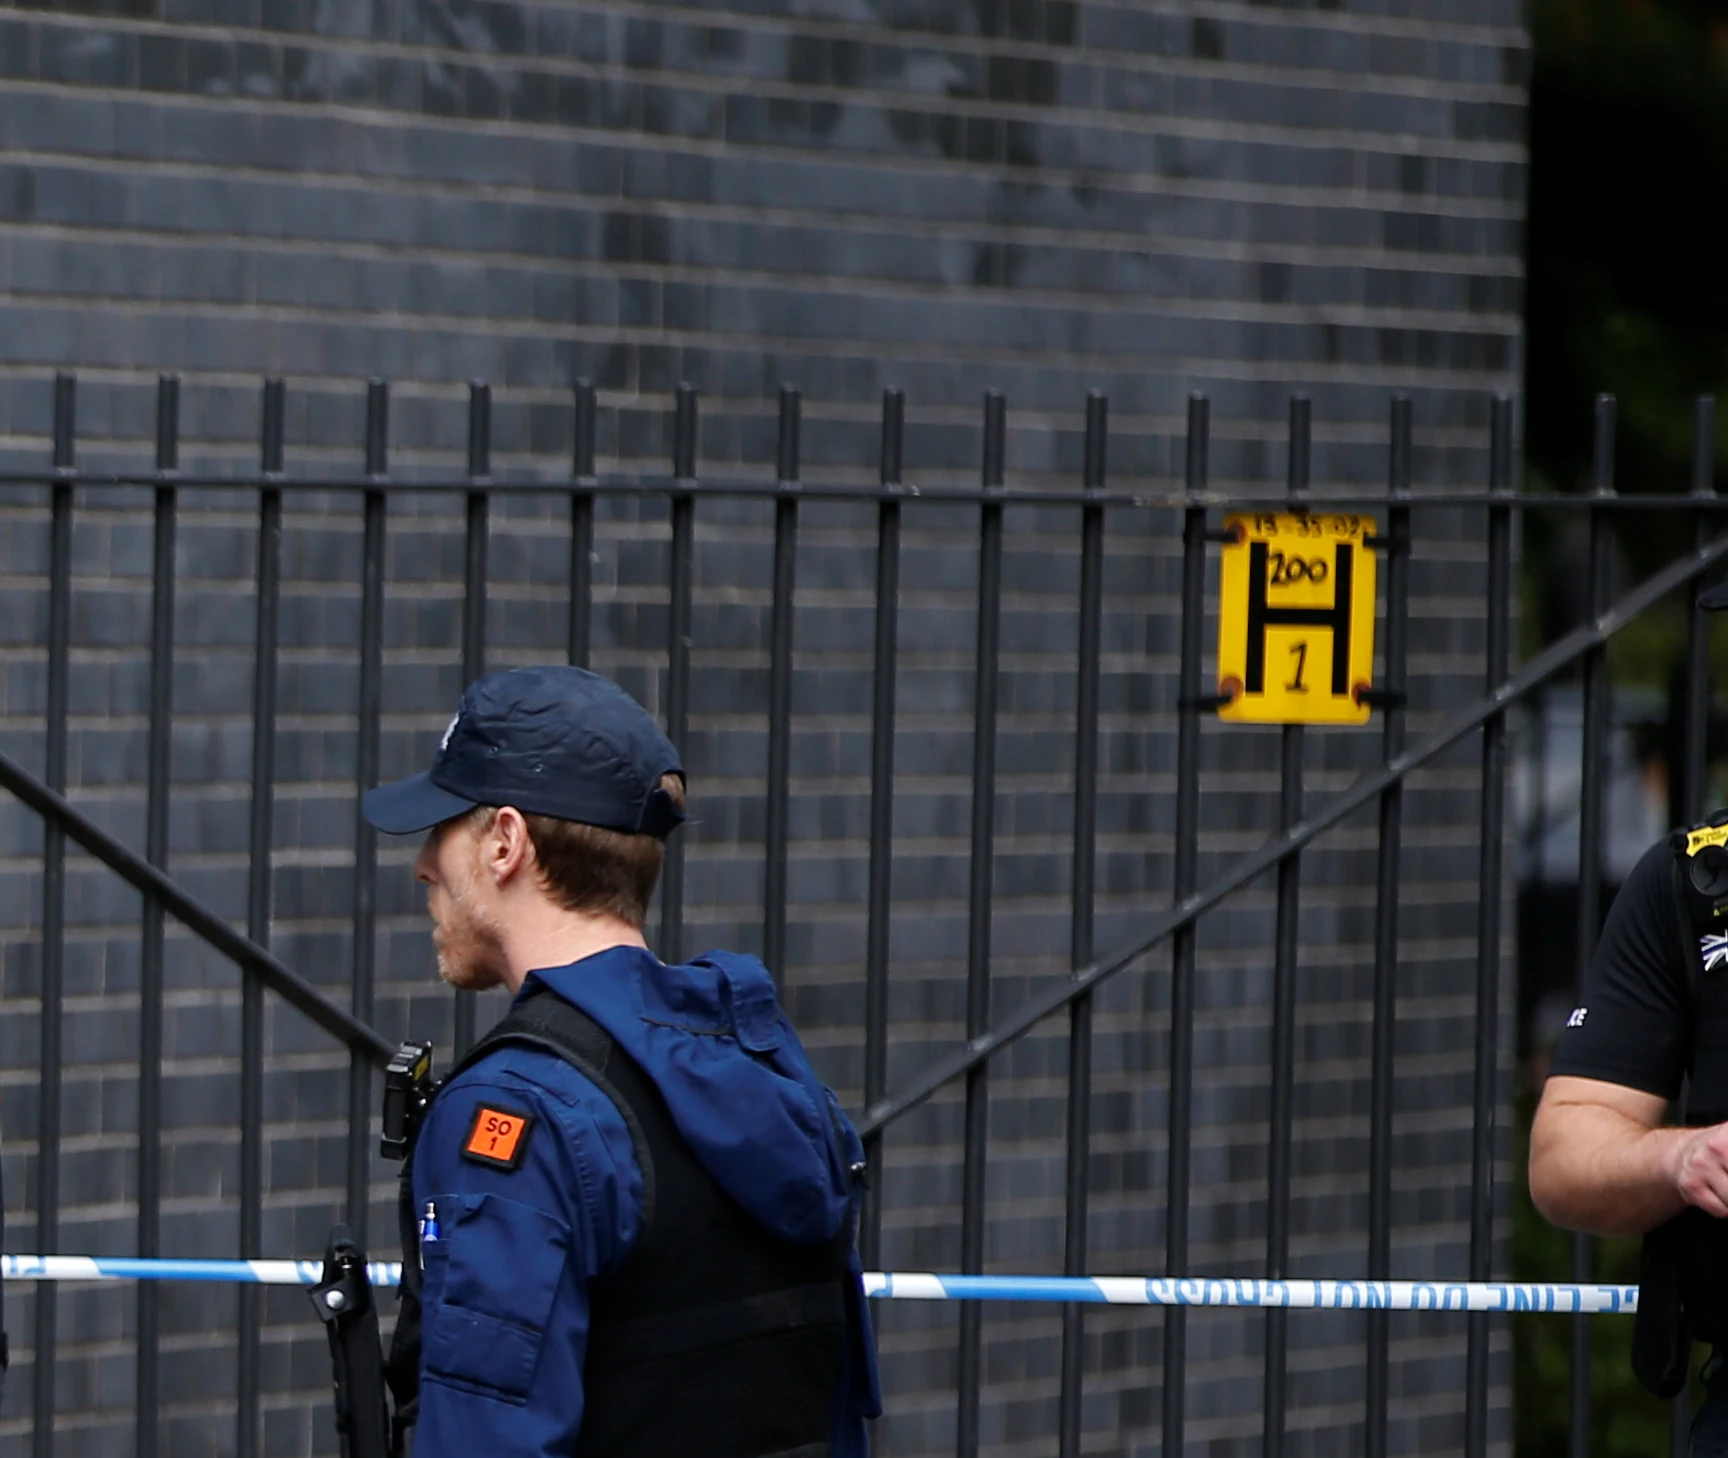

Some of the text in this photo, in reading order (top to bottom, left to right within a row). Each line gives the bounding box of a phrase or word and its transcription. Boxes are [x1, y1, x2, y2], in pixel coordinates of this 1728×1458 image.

[1269, 549, 1328, 586] 200
[1245, 541, 1354, 695] H
[1285, 640, 1310, 694] 1
[486, 1117, 512, 1136] SO
[489, 1136, 498, 1151] 1
